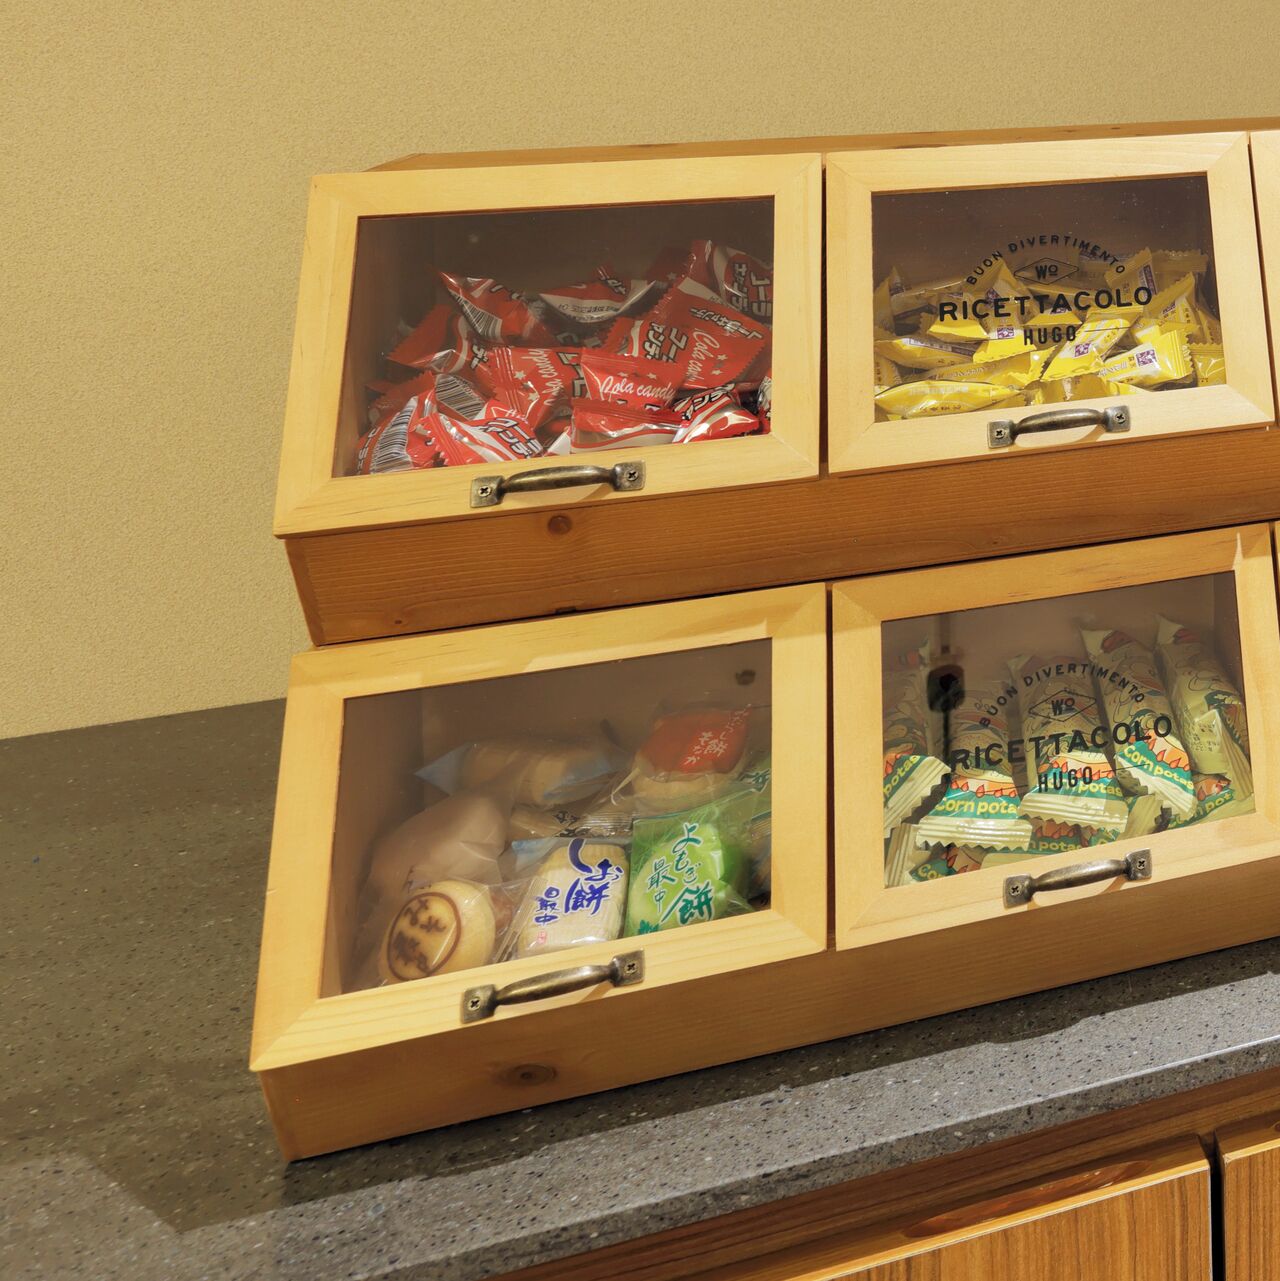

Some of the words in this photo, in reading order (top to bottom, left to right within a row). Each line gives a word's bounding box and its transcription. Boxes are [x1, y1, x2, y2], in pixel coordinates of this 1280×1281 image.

[966, 250, 1003, 285] BUON
[1007, 234, 1126, 274] DIVERTIMENTO
[938, 286, 1153, 323] RICETTACOLO
[1023, 325, 1077, 346] HUGO
[979, 686, 1018, 728] BUON
[1023, 663, 1145, 703] DIVERTIMENTO
[949, 714, 1172, 772] RICETTACOLO
[1123, 744, 1155, 773] Corn
[1038, 766, 1093, 793] HUGO
